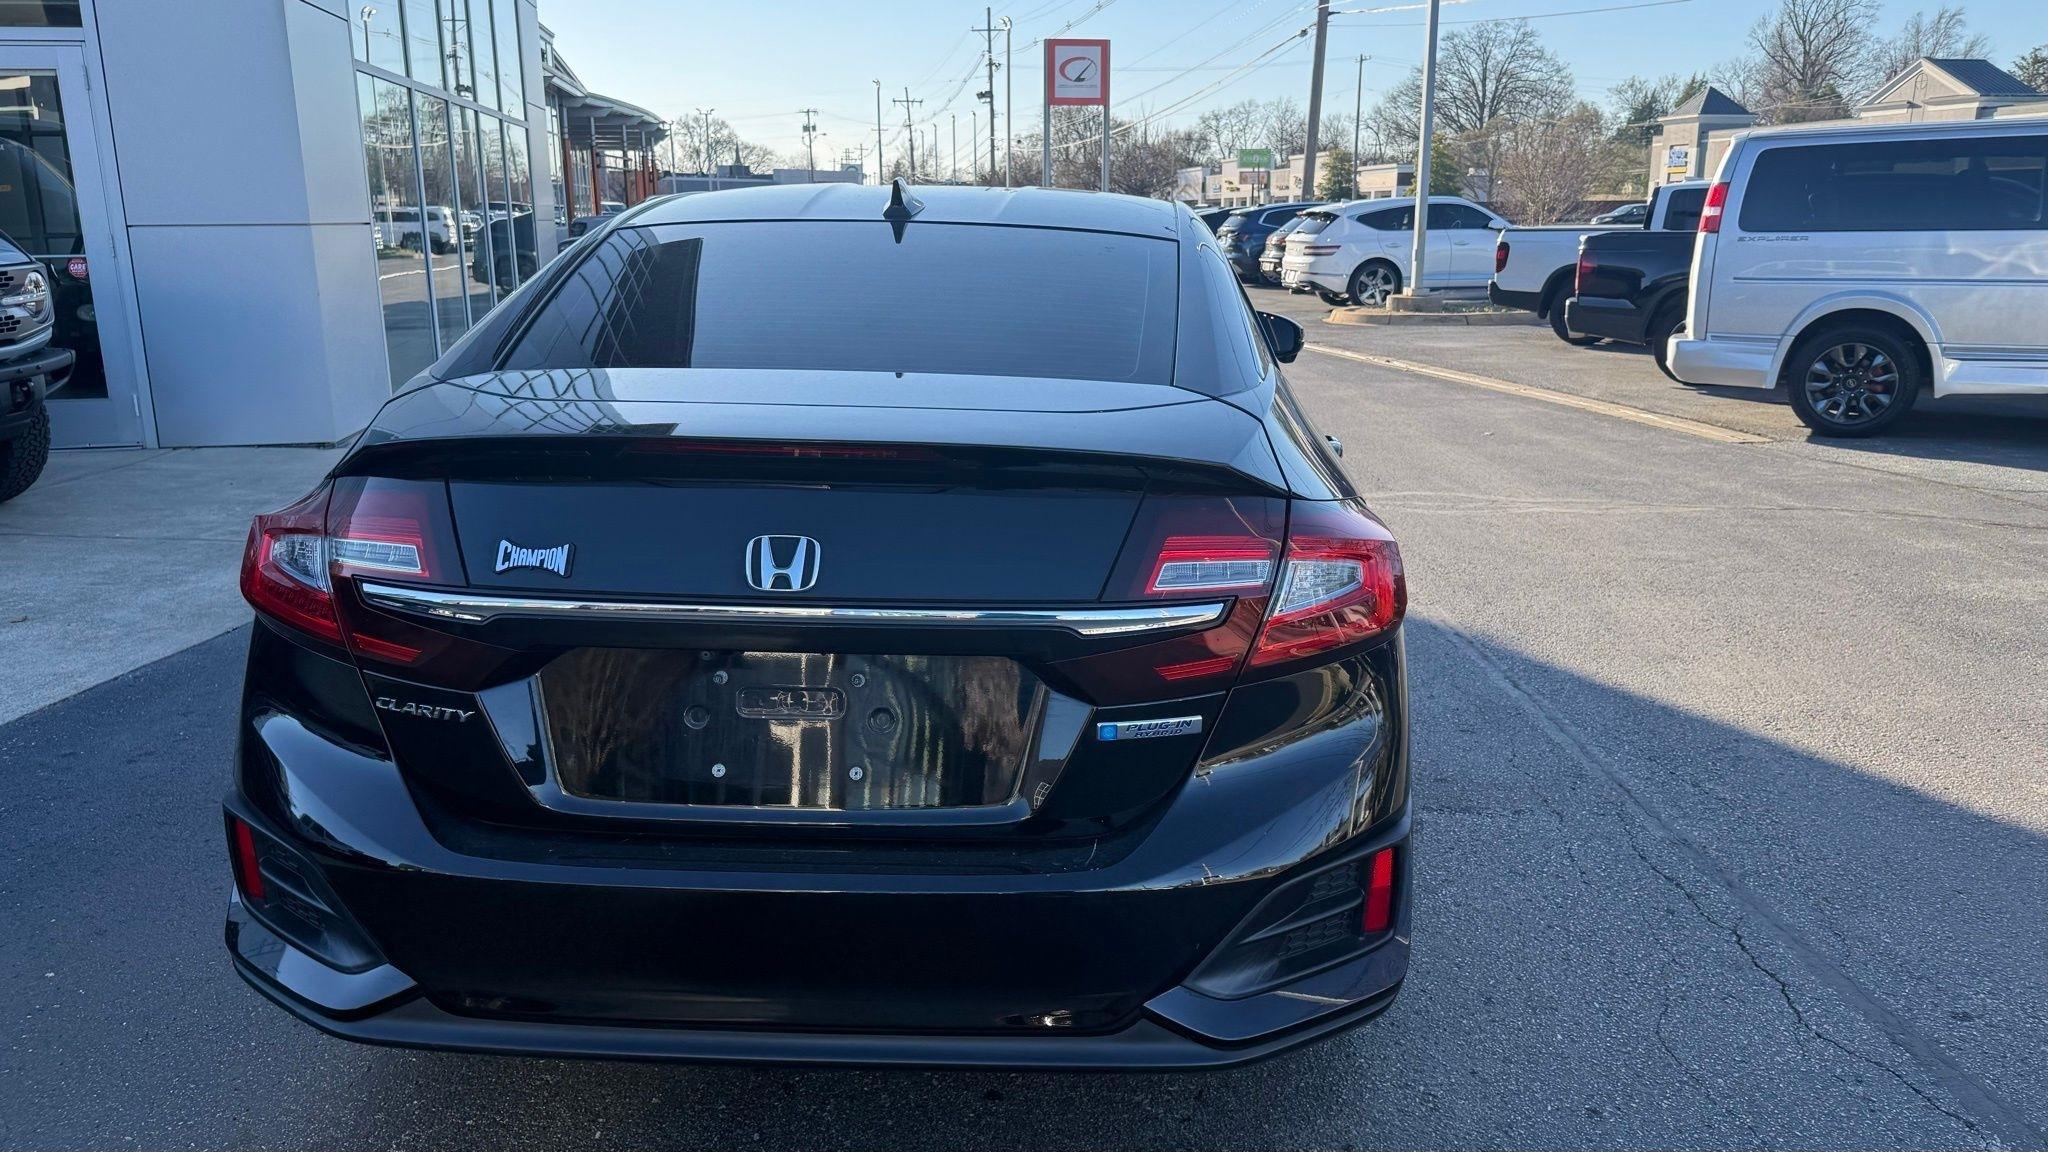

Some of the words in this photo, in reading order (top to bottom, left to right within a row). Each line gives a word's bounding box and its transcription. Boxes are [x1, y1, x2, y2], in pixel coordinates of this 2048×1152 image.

[495, 539, 570, 576] CHAMPION
[376, 697, 475, 722] CLARITY
[1126, 719, 1193, 732] PLUG-IN
[1134, 729, 1183, 739] HYBRID
